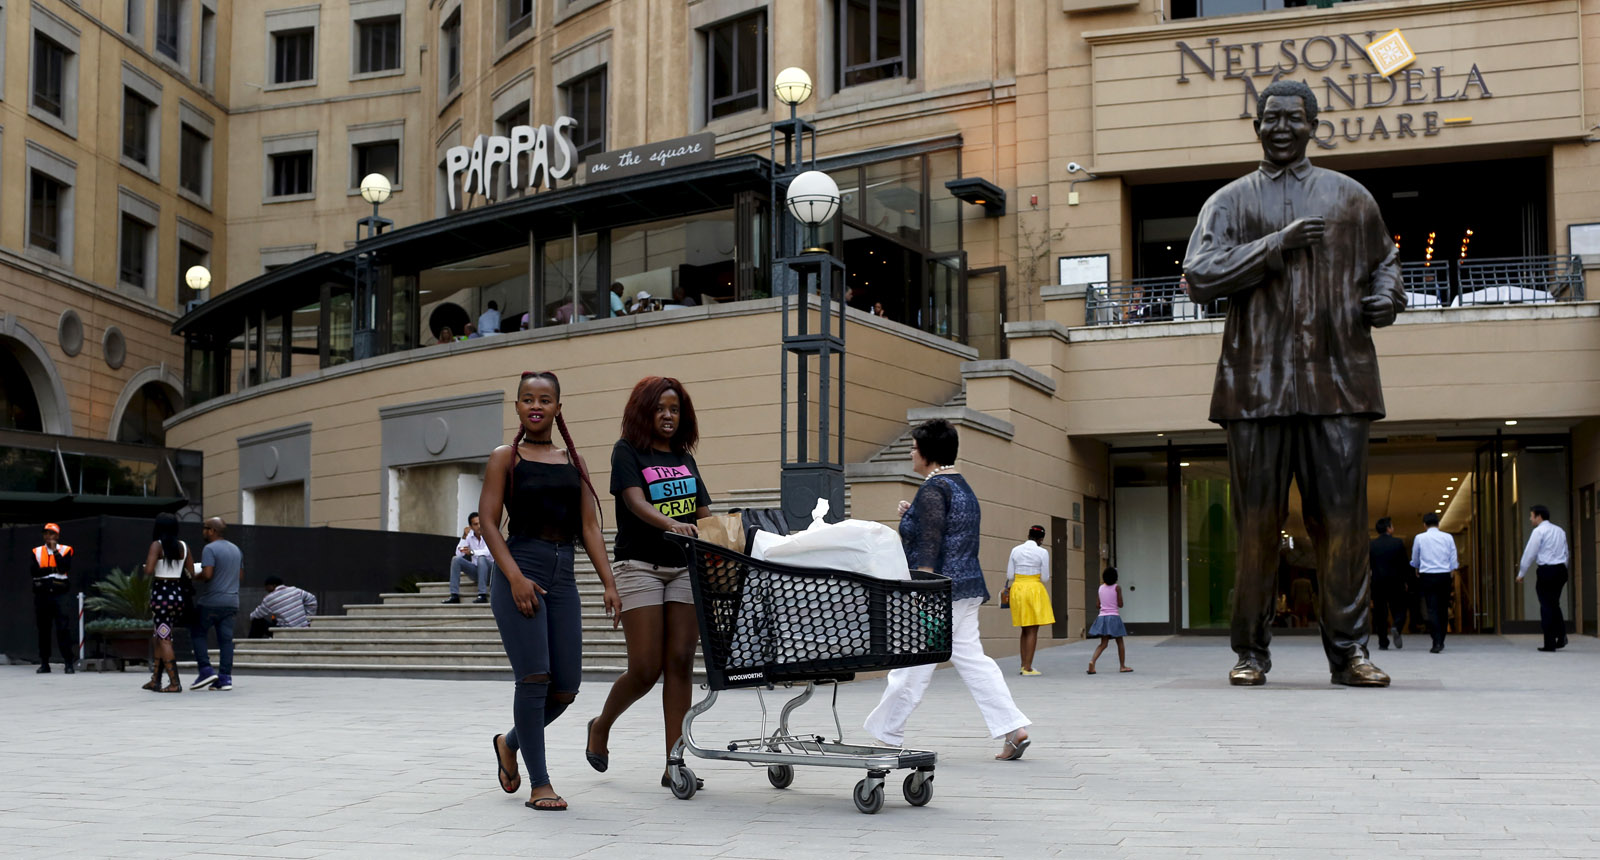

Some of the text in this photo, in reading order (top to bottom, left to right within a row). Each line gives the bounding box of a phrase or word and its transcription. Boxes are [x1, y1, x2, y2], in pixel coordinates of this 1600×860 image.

[1176, 30, 1377, 84] NELSON
[1239, 63, 1492, 118] MNDELA
[1312, 111, 1440, 149] QUARE
[446, 115, 578, 211] PAPPAS
[591, 143, 703, 173] on the square
[651, 467, 684, 478] THA
[663, 480, 688, 497] SHI
[659, 498, 696, 516] CRAY
[728, 671, 763, 681] WOOLWORTHS
